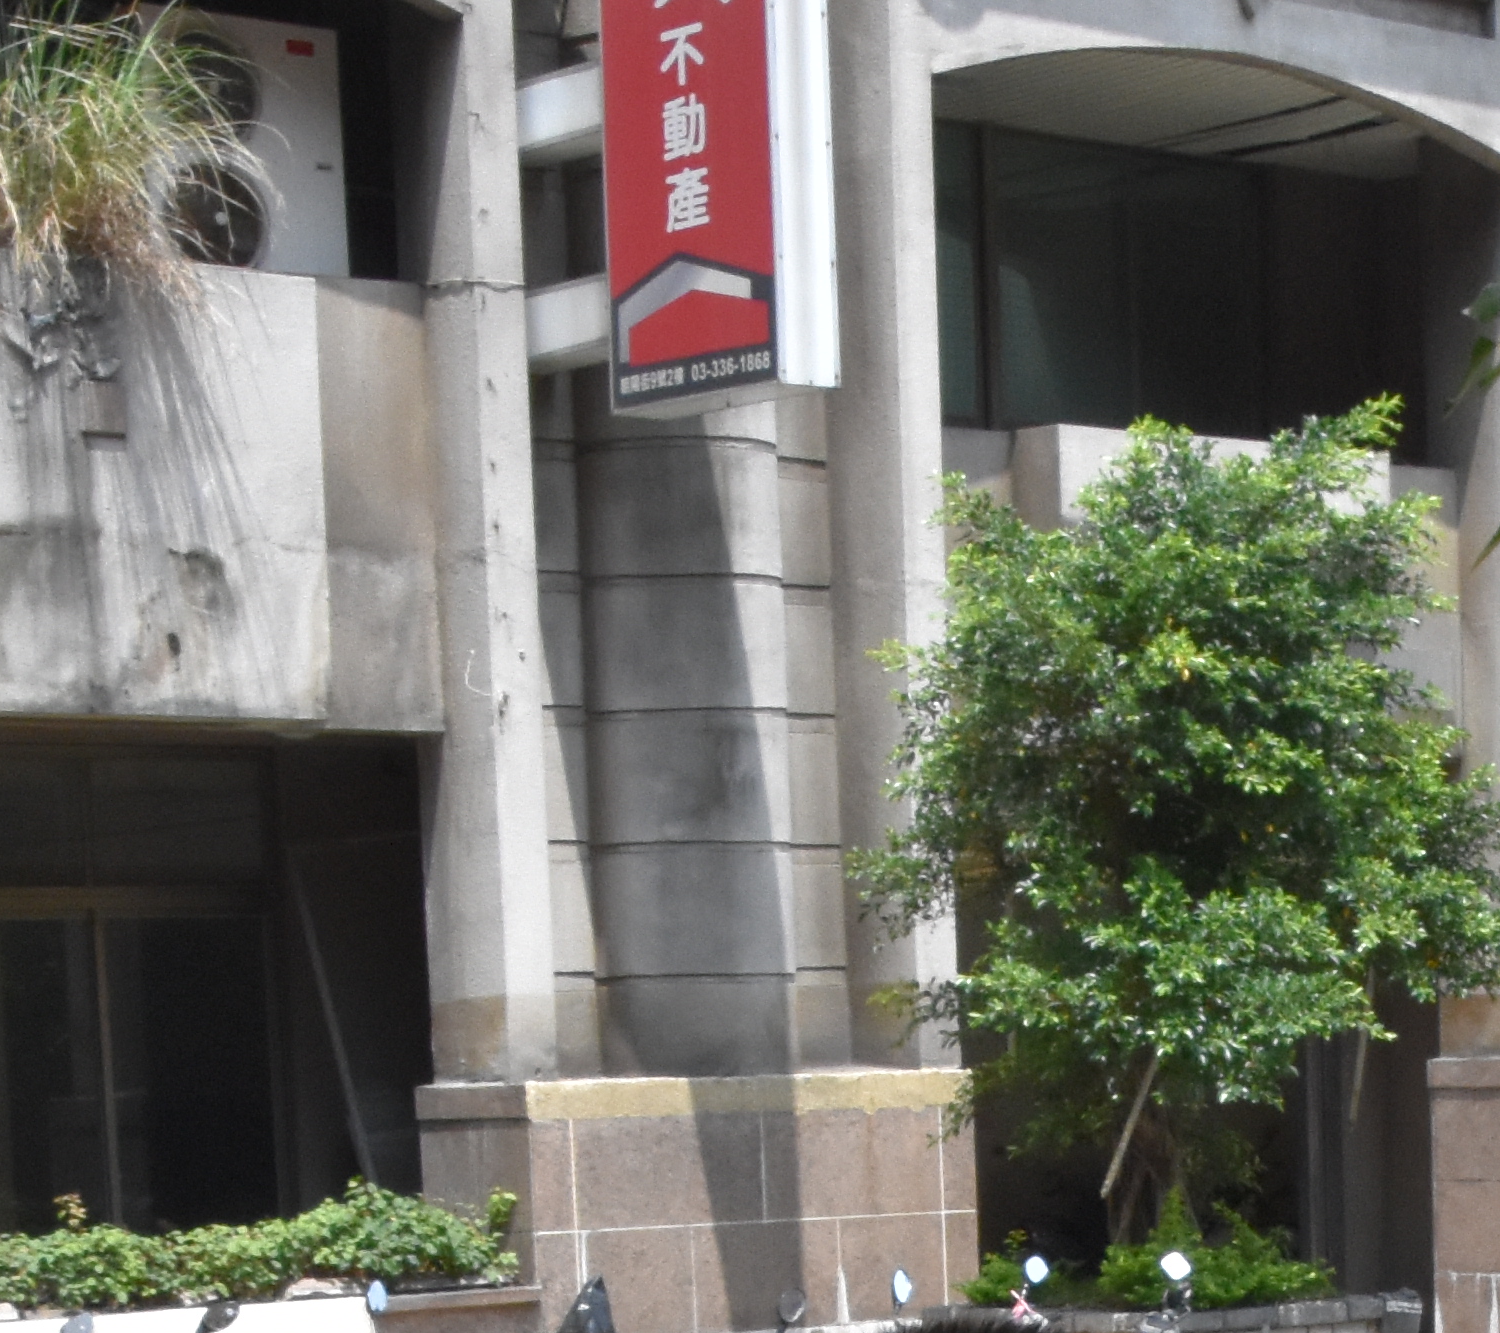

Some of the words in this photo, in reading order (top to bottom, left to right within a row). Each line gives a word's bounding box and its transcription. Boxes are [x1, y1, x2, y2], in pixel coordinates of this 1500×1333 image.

[660, 21, 710, 233] 不動產
[691, 351, 772, 381] 03-336-1868
